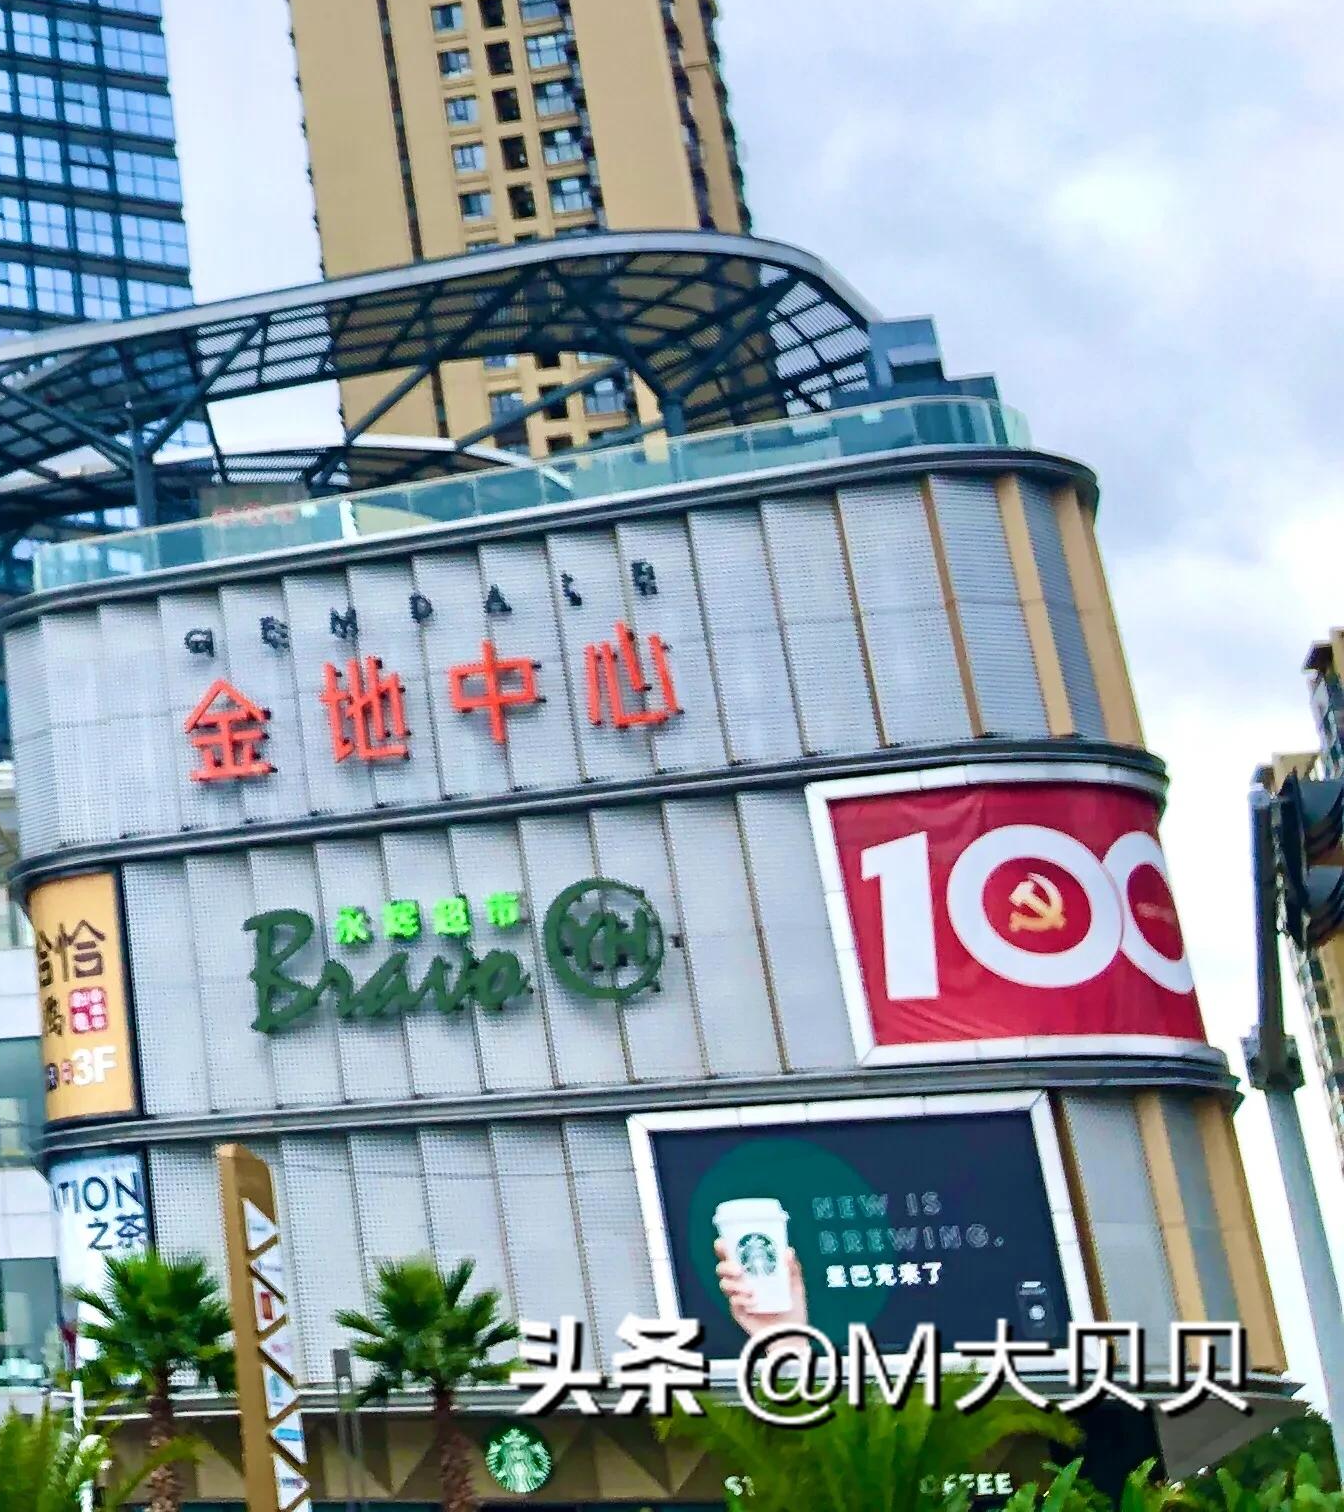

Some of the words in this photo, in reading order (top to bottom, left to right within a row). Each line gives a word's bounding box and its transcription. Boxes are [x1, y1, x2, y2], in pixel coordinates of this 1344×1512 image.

[184, 620, 685, 783] 金地中心
[334, 891, 520, 944] 永辉超市
[860, 824, 1202, 1002] 100
[242, 907, 534, 1034] Bravo
[71, 1045, 118, 1086] 3F
[54, 1172, 144, 1214] TION
[812, 1194, 888, 1220] NEW
[906, 1191, 942, 1217] IS
[819, 1223, 1005, 1255] BREWING.
